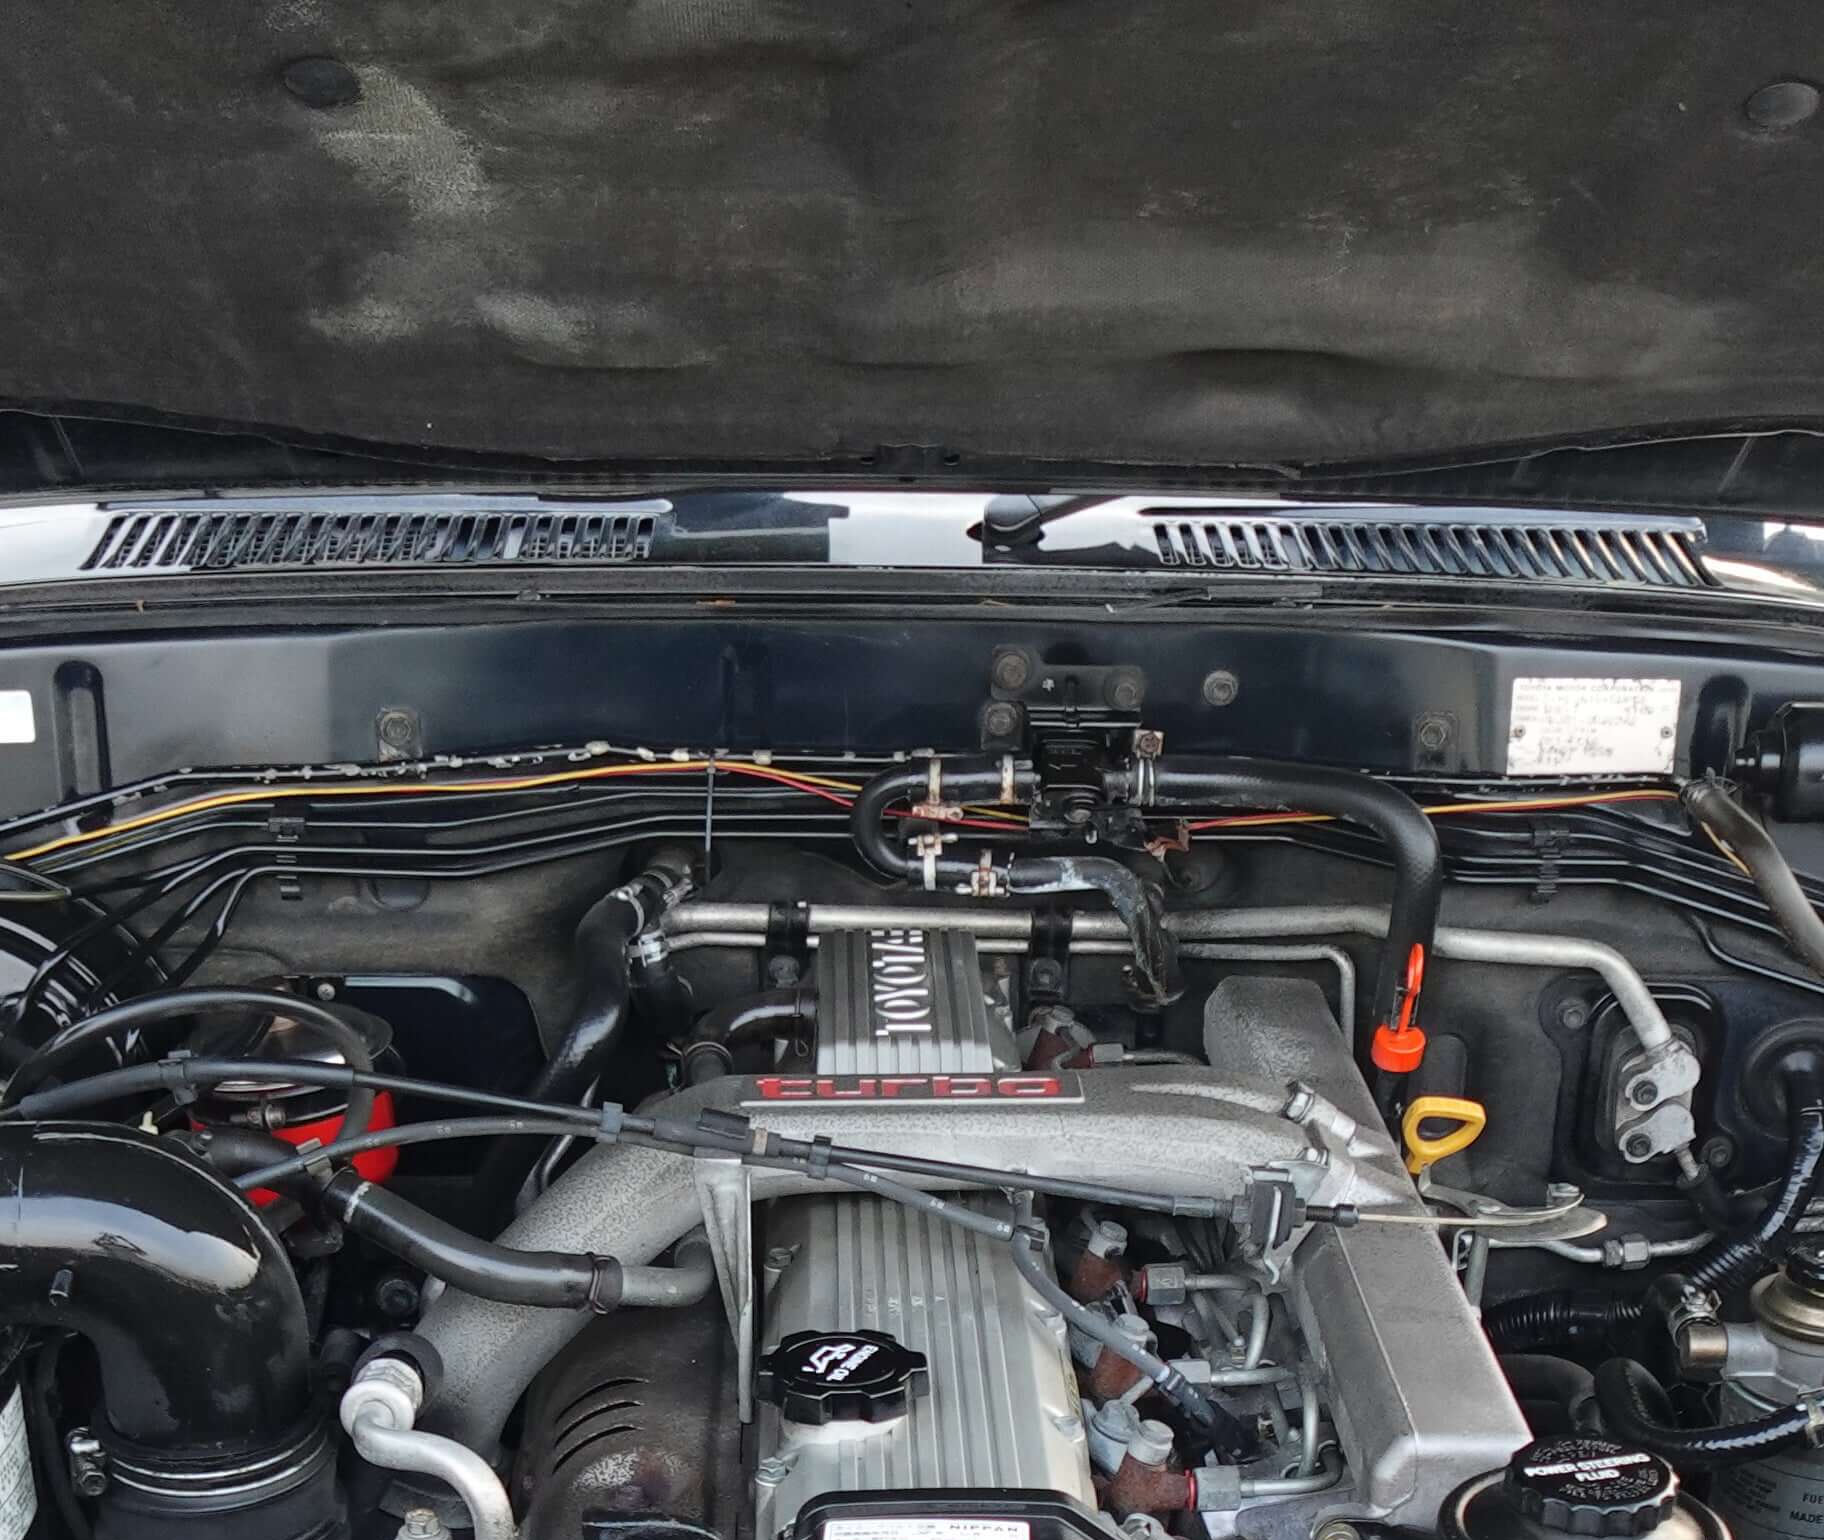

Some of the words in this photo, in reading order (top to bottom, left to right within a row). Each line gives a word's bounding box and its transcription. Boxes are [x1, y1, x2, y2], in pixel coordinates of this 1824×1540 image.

[870, 931, 933, 1037] TOYOTA
[756, 1075, 1063, 1099] turbo
[840, 1343, 880, 1371] ENGINE
[825, 1367, 850, 1382] OIL
[1523, 1462, 1578, 1478] POWER
[1577, 1452, 1652, 1472] STEERING
[1573, 1468, 1621, 1483] FLUID
[1789, 1510, 1824, 1525] MADE
